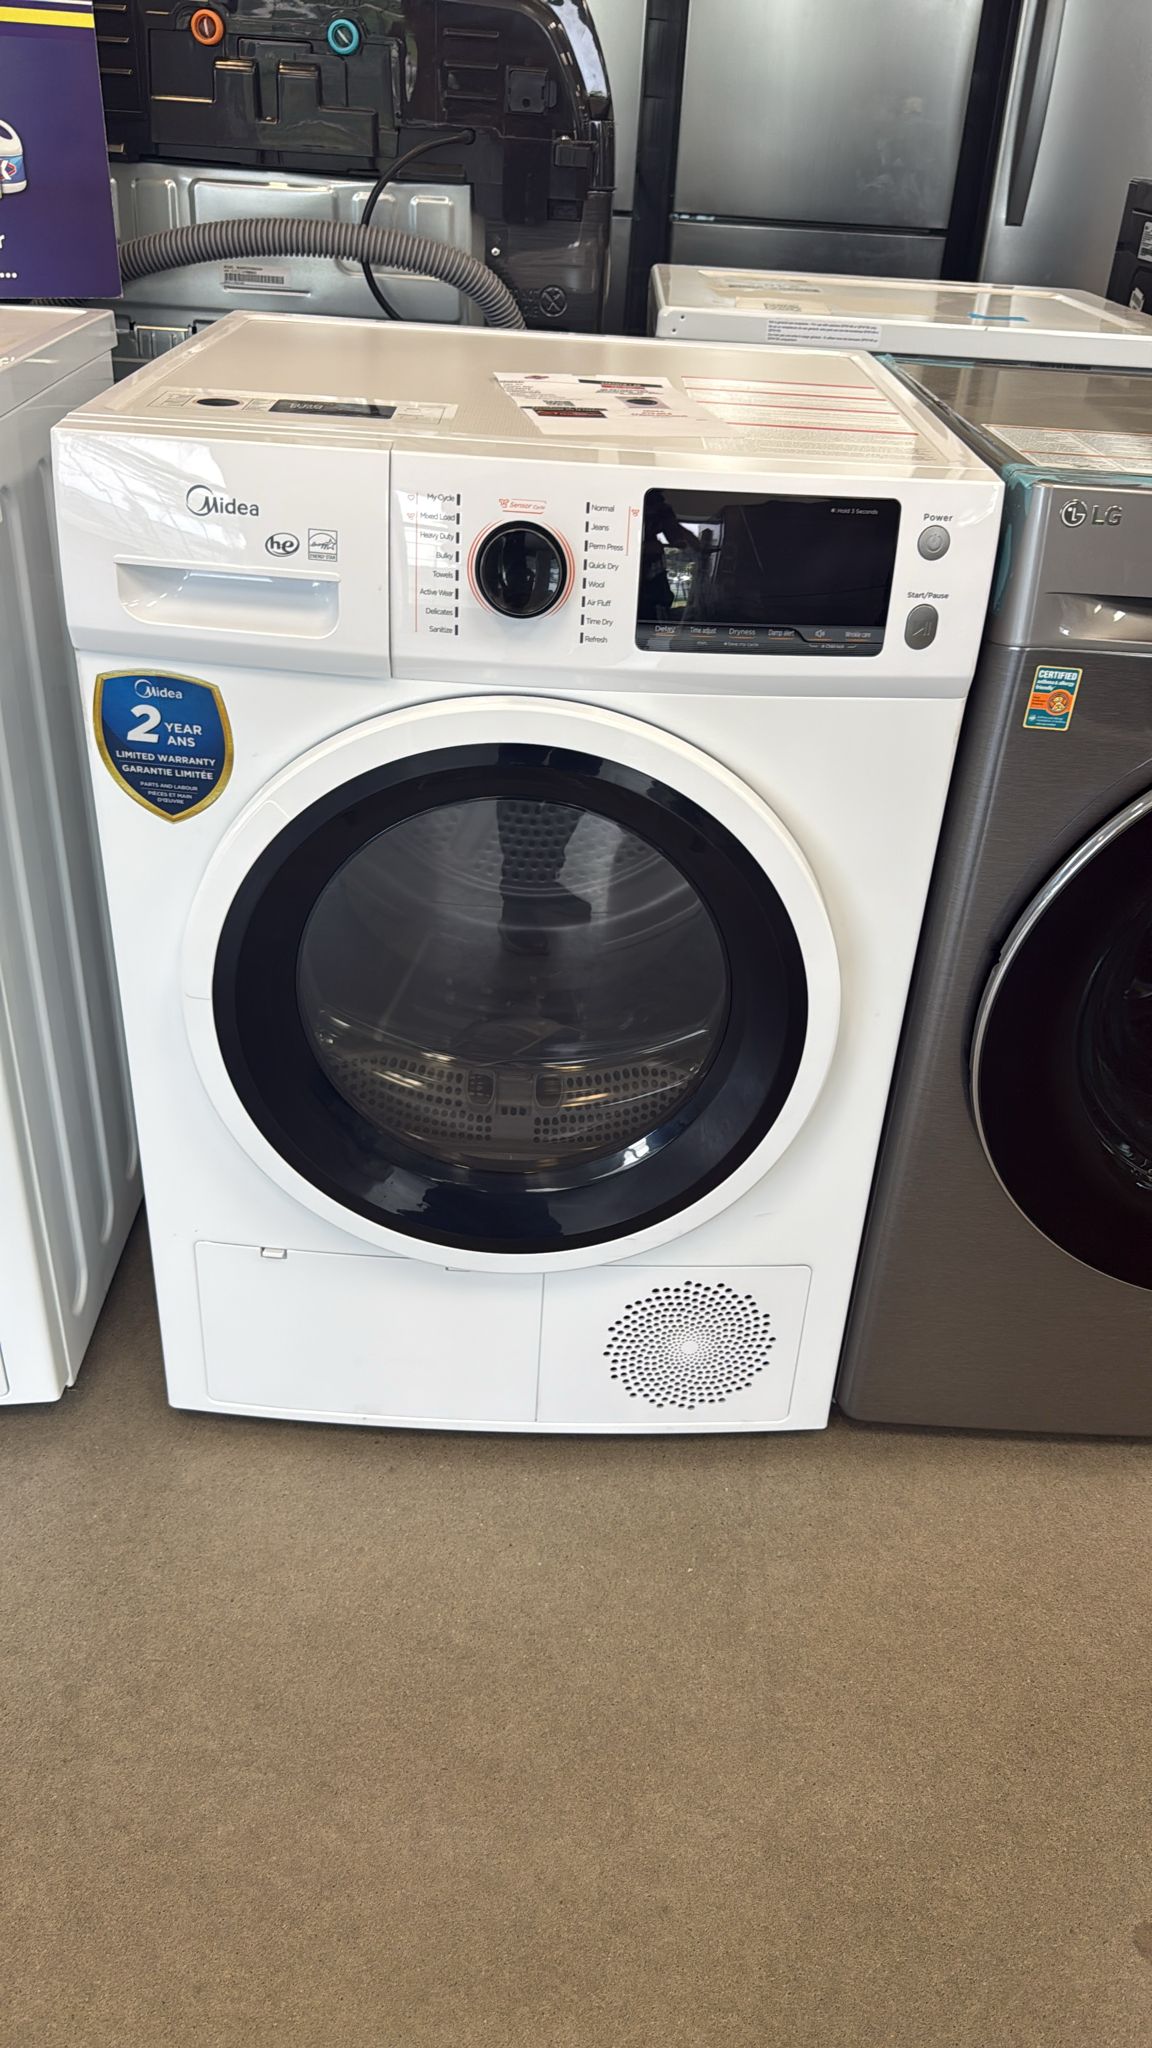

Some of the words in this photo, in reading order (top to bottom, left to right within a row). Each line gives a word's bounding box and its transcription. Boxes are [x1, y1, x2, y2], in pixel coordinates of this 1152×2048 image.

[186, 484, 260, 517] Midea
[427, 493, 438, 502] My
[437, 494, 455, 502] Cycle
[420, 512, 438, 520] Mixed
[923, 513, 953, 522] Power
[1091, 504, 1123, 525] LG
[420, 532, 438, 540] Heavy
[440, 533, 454, 541] Duty
[269, 535, 296, 554] he
[589, 543, 606, 551] Perm
[436, 551, 454, 560] Bulky
[588, 561, 606, 569] Quick
[607, 562, 619, 572] Dry
[433, 570, 453, 579] Towels
[420, 588, 438, 596] Active
[439, 590, 454, 598] Wear
[907, 591, 949, 600] Start/Pause
[597, 599, 612, 607] Fluff
[425, 607, 454, 616] Delicates
[586, 617, 601, 625] Time
[602, 618, 614, 627] Dry
[429, 625, 454, 634] Sanitize
[655, 625, 677, 633] Delay
[729, 628, 756, 636] Dryness
[585, 635, 608, 643] Refresh
[1038, 670, 1078, 681] CERTIFIED
[135, 679, 183, 699] Midea
[127, 704, 161, 743] 2
[164, 722, 202, 735] YEAR
[167, 736, 196, 748] ANS
[116, 750, 155, 761] LIMITED
[157, 753, 216, 767] WARRANTY
[121, 764, 173, 776] GARANTIE
[175, 768, 214, 780] LIMITÉE
